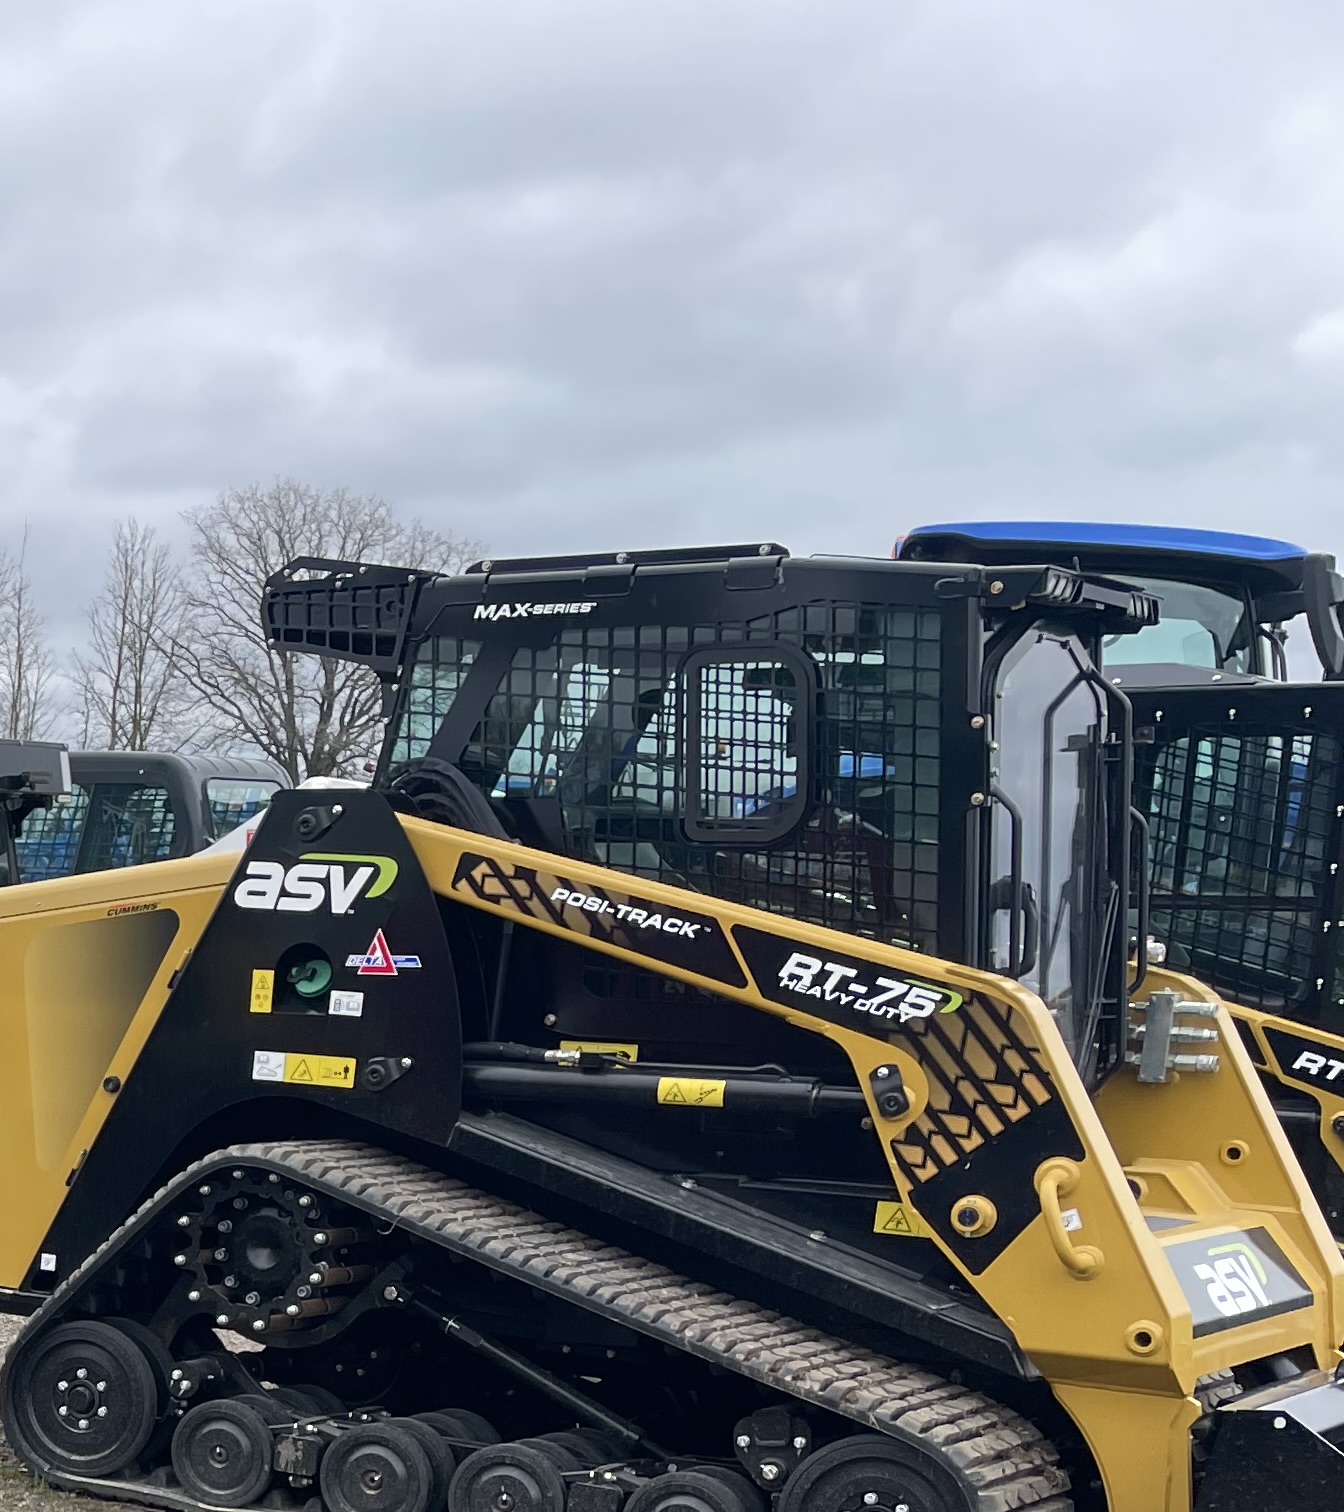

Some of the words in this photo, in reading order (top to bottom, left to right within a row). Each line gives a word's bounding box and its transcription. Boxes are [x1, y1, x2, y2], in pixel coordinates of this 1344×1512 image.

[107, 902, 158, 917] CUMMINS
[550, 887, 702, 939] POSI-TRACK
[778, 952, 944, 1018] RT-75
[779, 976, 856, 1005] HEAVY
[852, 997, 914, 1023] DUTY
